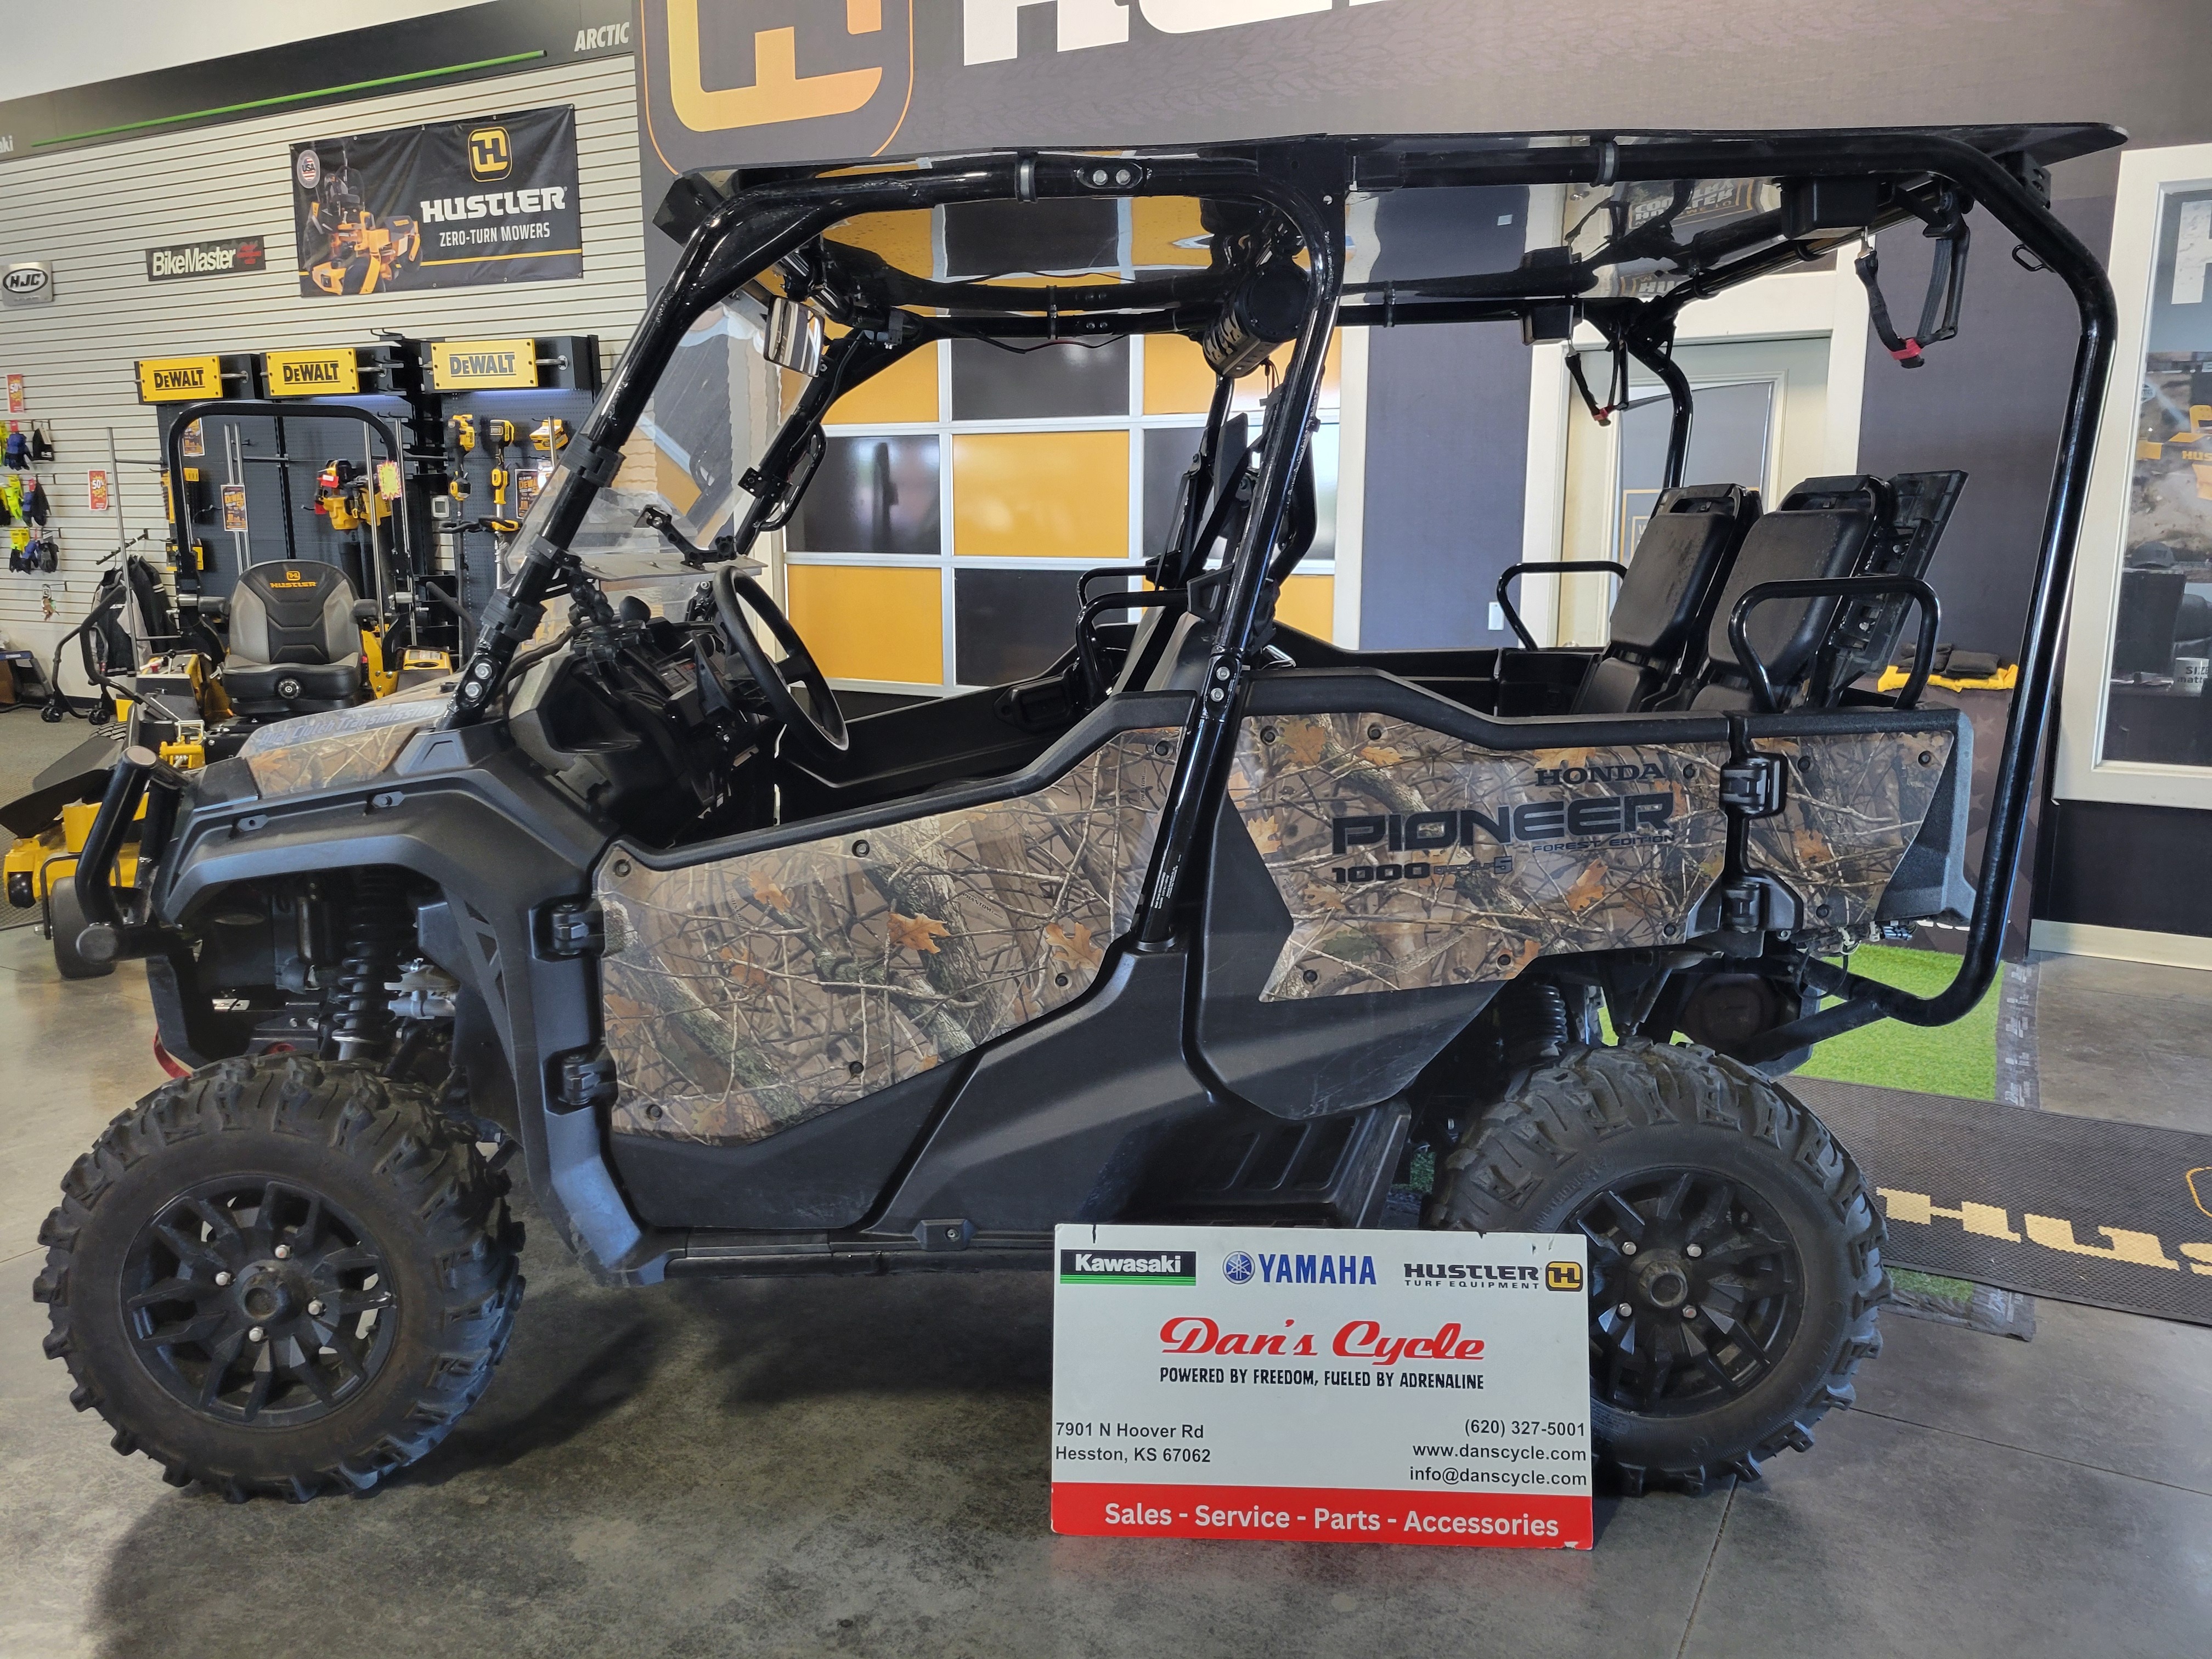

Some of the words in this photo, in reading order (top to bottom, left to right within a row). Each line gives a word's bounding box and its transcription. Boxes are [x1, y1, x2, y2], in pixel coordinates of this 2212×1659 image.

[574, 22, 629, 52] ARCTIC
[302, 163, 316, 172] USA
[420, 186, 566, 223] HUSTLER
[439, 227, 497, 247] ZERO-TURN
[501, 222, 550, 241] MOWERS
[153, 246, 236, 276] BikeMaster
[10, 274, 41, 287] HJC
[283, 363, 339, 382] DEWALT
[449, 354, 516, 375] DEWALT
[154, 370, 204, 388] DEWALT
[291, 720, 335, 739] Clutch
[336, 706, 438, 731] Transmission
[1535, 763, 1666, 787] HONDA
[1333, 793, 1674, 854] PIONEER
[1532, 840, 1601, 853] FOREST
[1609, 835, 1675, 847] EDITION
[1332, 862, 1430, 883] 1000
[962, 892, 991, 912] PHANTOM
[1075, 1254, 1181, 1273] Kawasaki
[1258, 1254, 1376, 1284] YAMAHA
[1404, 1263, 1539, 1280] HUSTLER
[1449, 1280, 1539, 1289] EQUIPMENT
[1160, 1317, 1318, 1356] Dan's
[1333, 1321, 1485, 1365] Cycle
[1160, 1367, 1224, 1384] POWERED
[1231, 1369, 1248, 1384] BY
[1254, 1369, 1319, 1386] FREEDOM,
[1324, 1370, 1370, 1386] FUELED
[1376, 1372, 1394, 1387] BY
[1400, 1373, 1484, 1390] ADRENALINE
[1056, 1422, 1092, 1436] 7901
[1100, 1423, 1110, 1436] N
[1117, 1423, 1176, 1437] Hoover
[1182, 1424, 1204, 1438] Rd
[1465, 1419, 1505, 1437] (620)
[1511, 1421, 1584, 1436] 327-5001
[1056, 1446, 1128, 1463] Hesston,
[1134, 1447, 1157, 1461] KS
[1163, 1448, 1211, 1462] 67062
[1413, 1443, 1587, 1463] www.danscycle.com
[1410, 1466, 1587, 1487] info@danscycle.com
[1105, 1503, 1172, 1525] Sales
[1195, 1505, 1290, 1528] Service
[1314, 1508, 1381, 1531] Parts
[1403, 1510, 1559, 1536] Accessories
